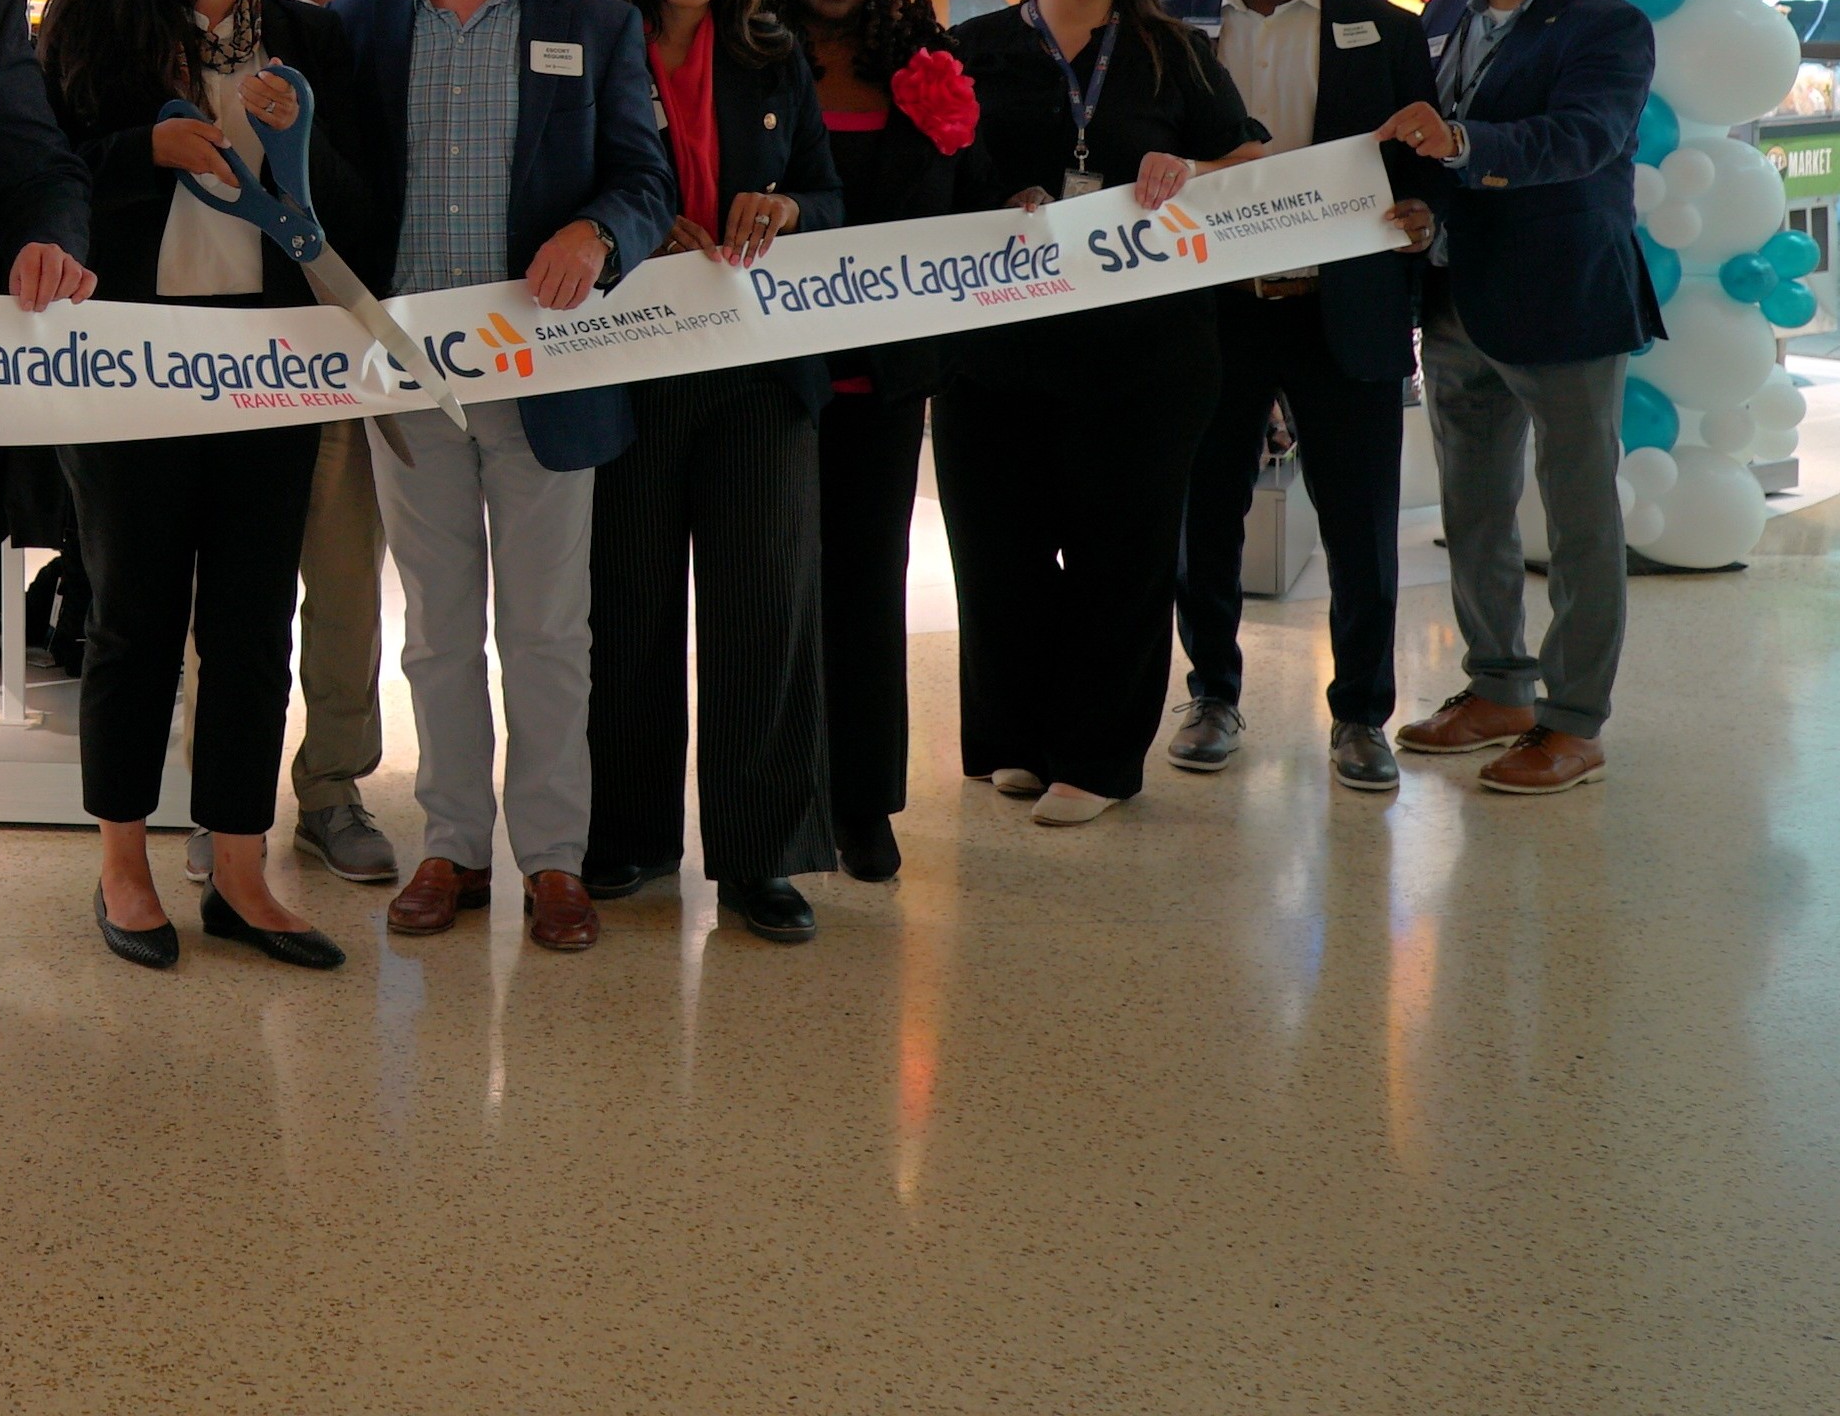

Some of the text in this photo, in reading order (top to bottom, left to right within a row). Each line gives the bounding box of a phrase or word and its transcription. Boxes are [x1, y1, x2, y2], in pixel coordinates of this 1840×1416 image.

[1788, 147, 1832, 179] MARKET
[1205, 190, 1324, 227] SAN JOSE MINETA
[1214, 194, 1378, 243] INTERNATIONAL AIRPORT
[1088, 219, 1170, 273] SJC
[750, 234, 1060, 316] Paradies Lagardère
[972, 278, 1077, 307] TRAVEL RETAIL
[536, 304, 677, 342] SAN JOSE MINETA
[543, 308, 742, 358] INTERNATIONAL AIRPORT
[144, 338, 349, 401] Lagardère
[230, 393, 362, 409] TRAVEL RETAIL
